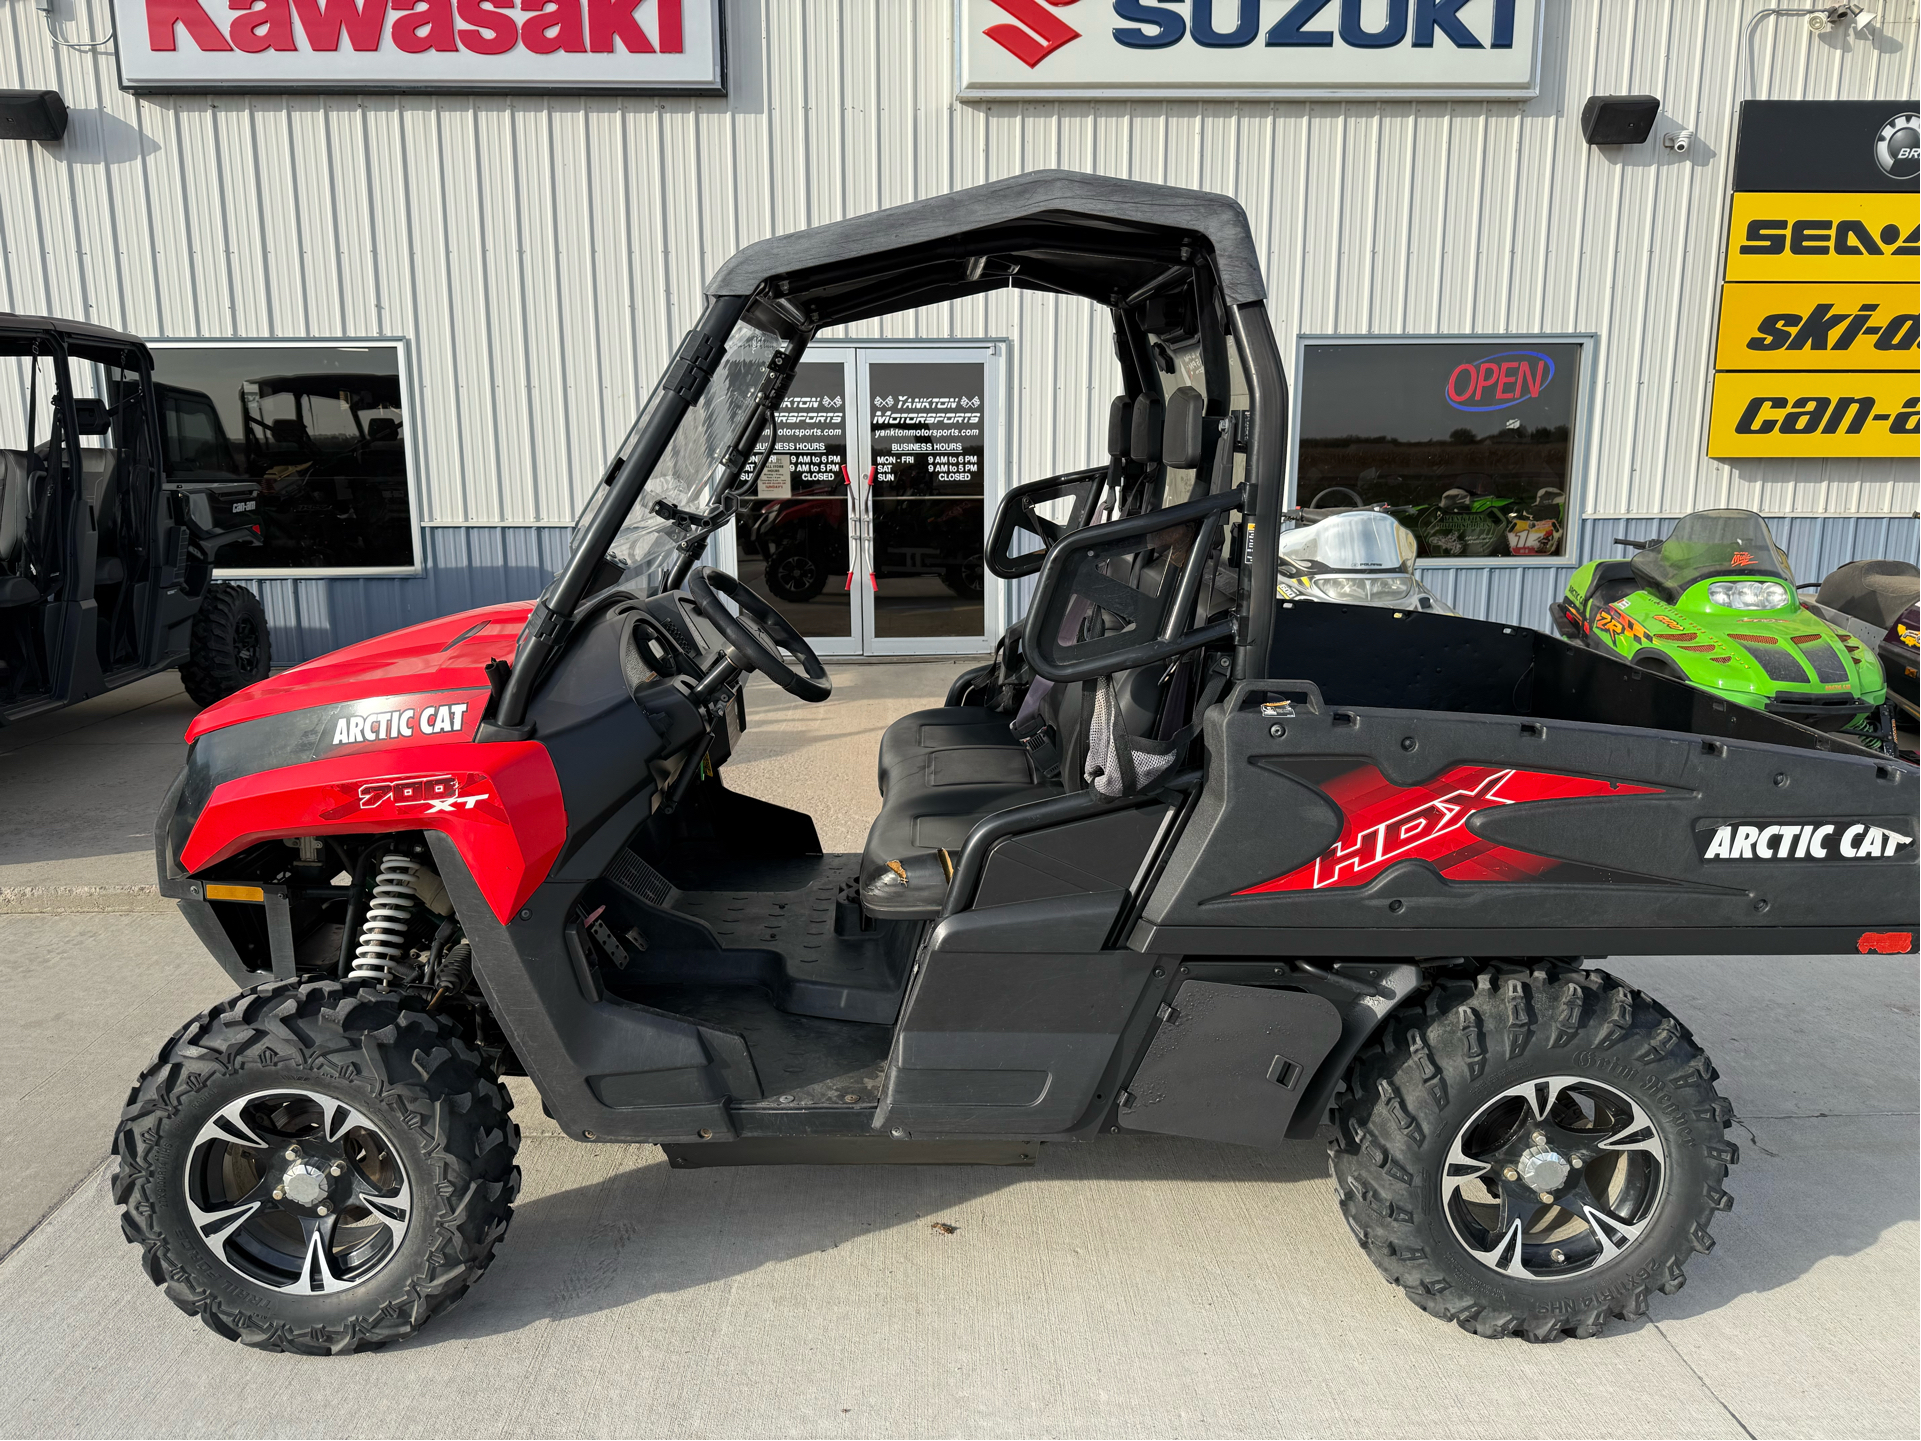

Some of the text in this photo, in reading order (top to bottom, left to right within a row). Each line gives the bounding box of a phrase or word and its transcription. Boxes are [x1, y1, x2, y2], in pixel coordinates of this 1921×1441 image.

[1112, 0, 1514, 49] SUZUKI
[1898, 148, 1920, 159] BR
[1746, 303, 1920, 351] ski-d
[1448, 361, 1544, 402] OPEN
[780, 397, 821, 408] KTON
[897, 395, 959, 409] YANKTON
[774, 412, 843, 423] RSPORTS
[873, 411, 981, 424] MOTORSPORTS
[1735, 396, 1920, 435] can-a
[875, 428, 979, 438] yanktonmotorsports.com
[755, 442, 825, 450] BUSNESS HOURS
[891, 443, 962, 451] BUSINESS HOURS
[790, 455, 797, 463] 9
[798, 455, 811, 463] AM
[821, 455, 827, 463] 6
[829, 455, 841, 463] PM
[877, 456, 896, 464] MON
[789, 464, 795, 472] 9
[796, 464, 809, 472] AM
[810, 464, 819, 472] to
[877, 464, 978, 472] SAT 9 AM to 5 PM
[877, 473, 971, 481] SUN CLOSED
[232, 501, 256, 513] can-am
[1514, 529, 1530, 548] 1
[1279, 584, 1296, 598] 600
[332, 702, 468, 746] ARCTIC CAT
[358, 775, 459, 809] 700
[423, 794, 489, 814] XT
[1312, 768, 1516, 889] HDX
[1704, 823, 1912, 859] ARCTIC CAT
[1535, 1296, 1578, 1316] NHS
